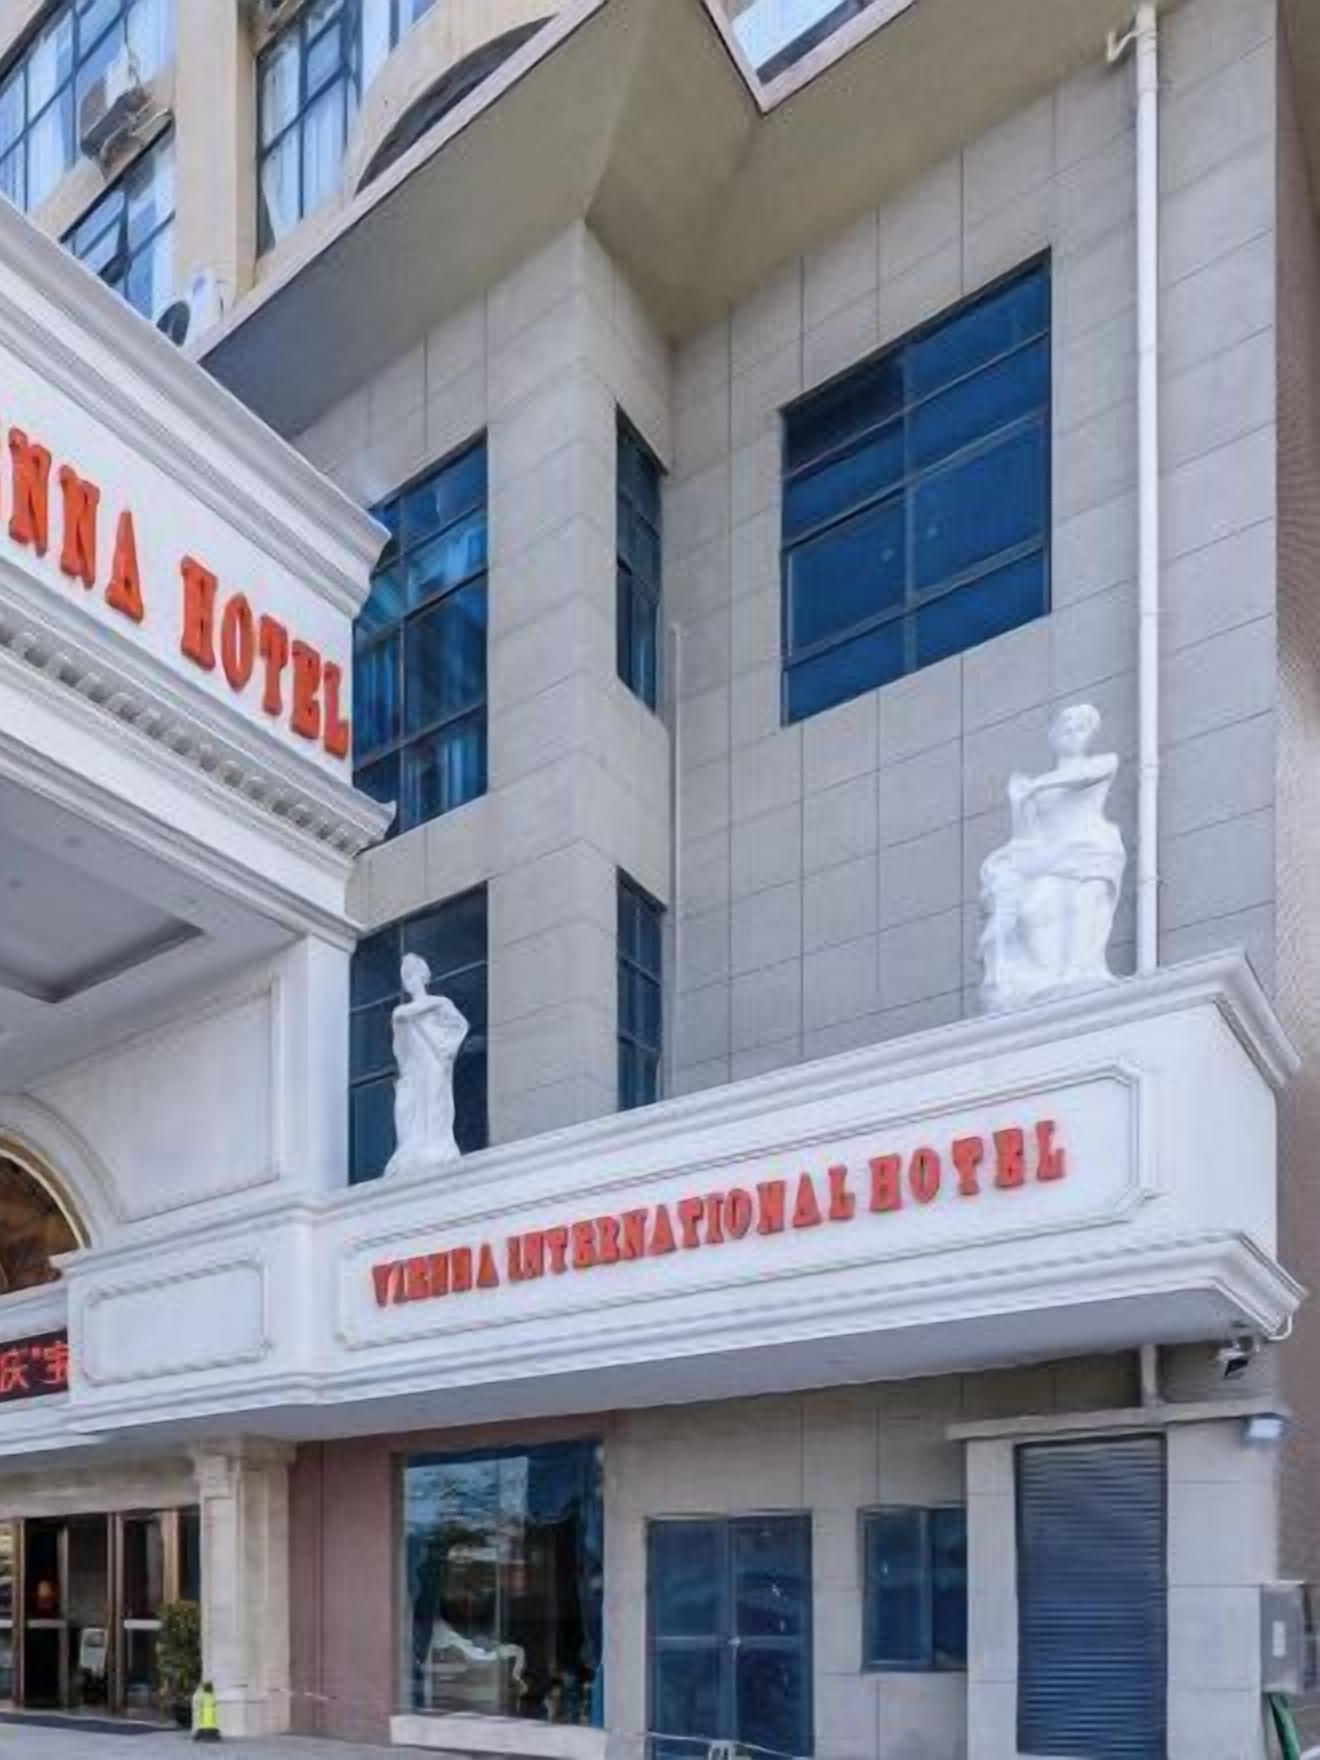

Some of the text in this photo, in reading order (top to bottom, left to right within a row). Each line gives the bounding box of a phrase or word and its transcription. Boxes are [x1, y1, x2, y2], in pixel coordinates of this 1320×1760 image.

[180, 554, 349, 760] HOTEL
[372, 1119, 1066, 1308] VIENNA INTERNATIONAL HOTEL
